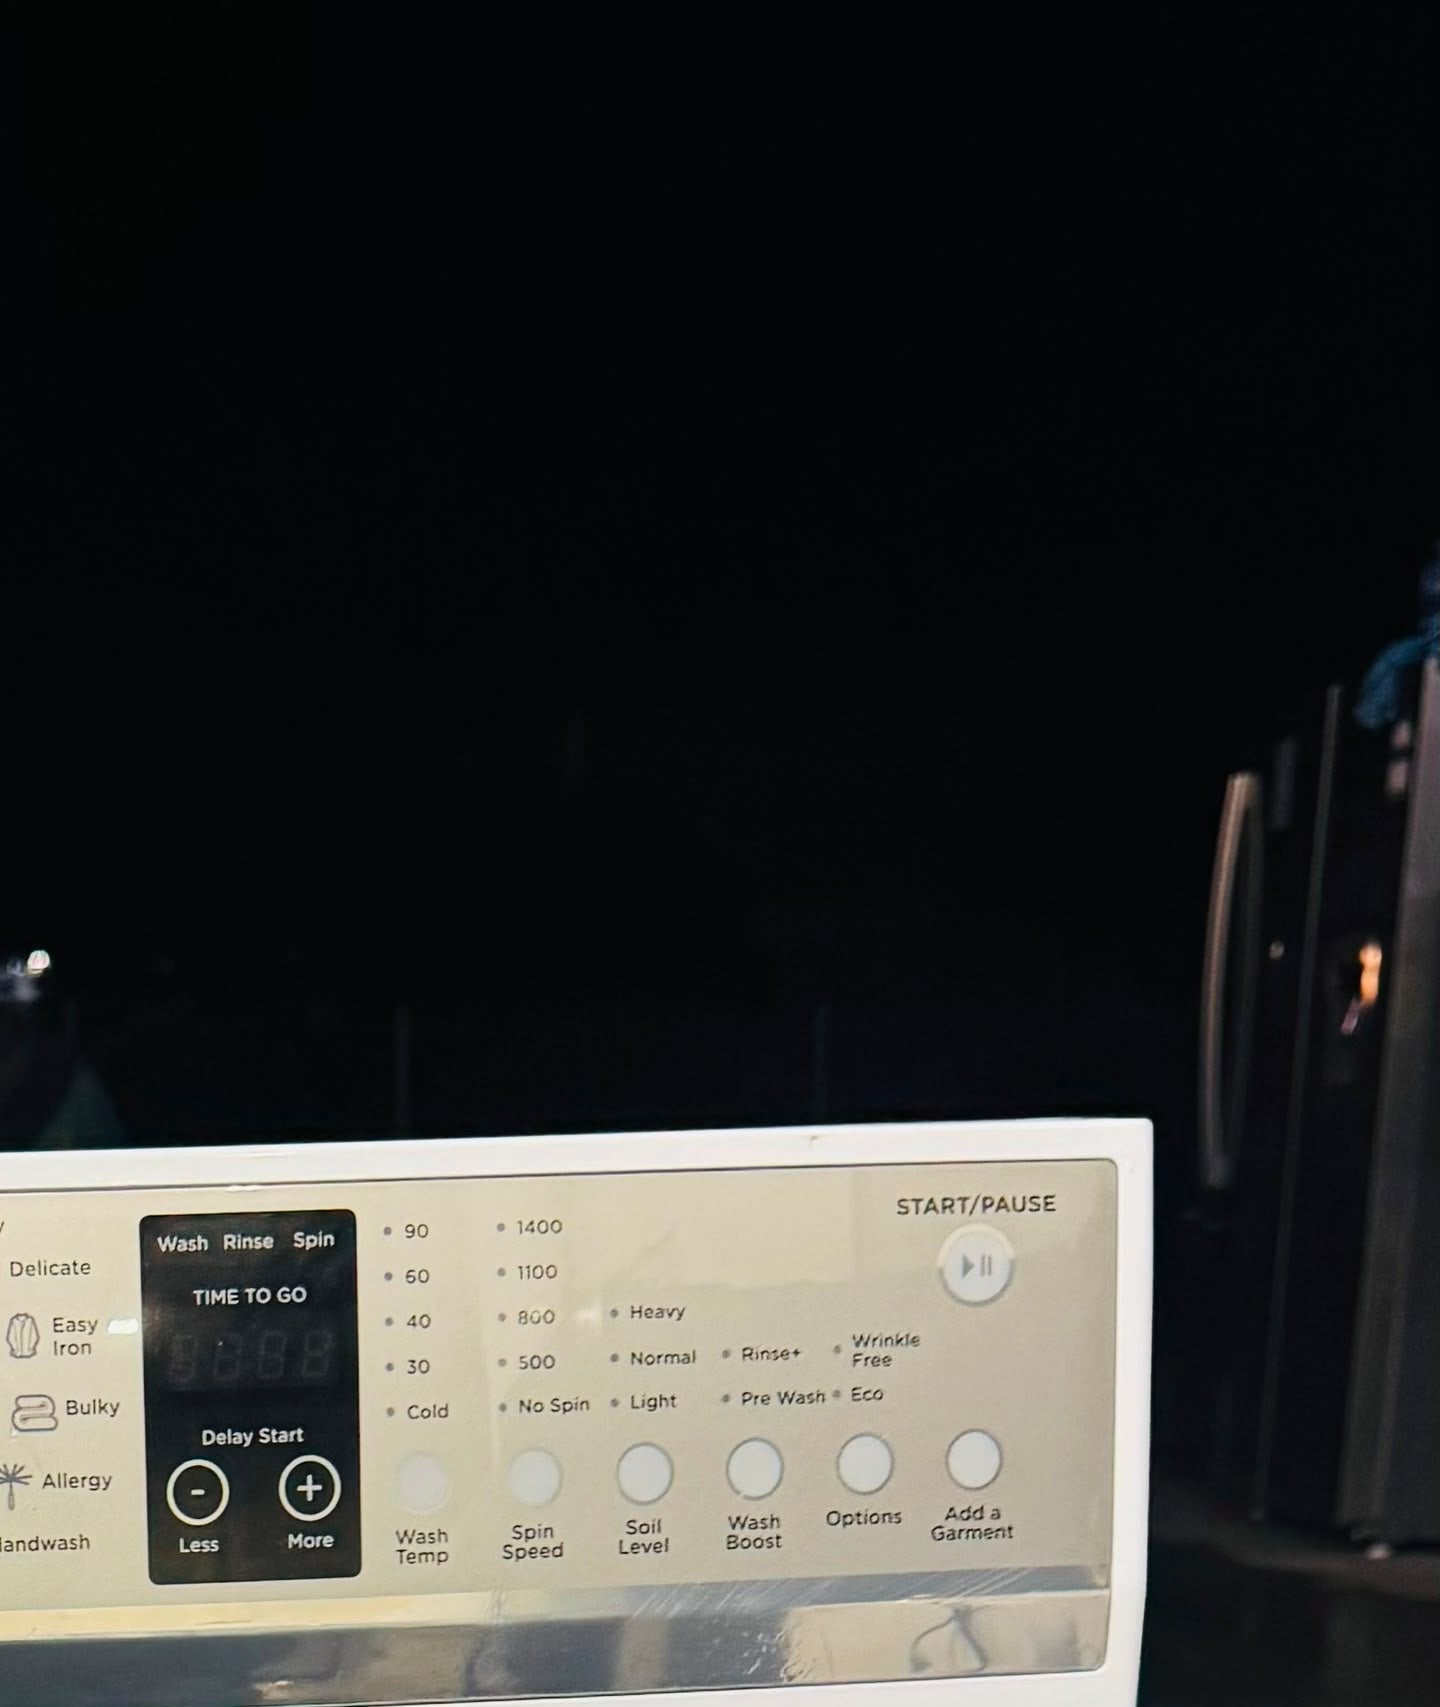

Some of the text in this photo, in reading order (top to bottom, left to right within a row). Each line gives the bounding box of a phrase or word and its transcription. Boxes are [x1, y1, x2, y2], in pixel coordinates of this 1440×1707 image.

[897, 1195, 1056, 1215] START/PAUSE
[405, 1224, 428, 1238] 90
[518, 1220, 562, 1234] 1400
[157, 1235, 208, 1252] Wash
[224, 1234, 273, 1250] Rinse
[294, 1231, 334, 1250] Spin
[10, 1260, 90, 1277] Delicate
[518, 1265, 557, 1279] 1100
[406, 1269, 429, 1284] 60
[193, 1287, 306, 1305] TIME TO GO
[519, 1309, 555, 1325] 800
[631, 1306, 685, 1321] Heavy
[53, 1317, 97, 1335] Easy
[407, 1314, 431, 1329] 40
[54, 1341, 91, 1355] Iron
[853, 1334, 920, 1347] Wrinkle
[631, 1350, 696, 1365] Normal
[742, 1347, 800, 1360] Rinse+
[853, 1353, 892, 1367] Free
[408, 1360, 430, 1374] 30
[520, 1355, 555, 1369] 500
[742, 1390, 825, 1405] Pre Wash
[852, 1387, 883, 1401] Eco
[67, 1399, 119, 1417] Bulky
[520, 1397, 589, 1414] No Spin
[631, 1394, 676, 1412] Light
[408, 1404, 448, 1419] Cold
[202, 1428, 304, 1447] Delay Start
[43, 1473, 111, 1491] Allergy
[827, 1511, 901, 1528] Options
[945, 1506, 1001, 1521] Add a
[626, 1520, 661, 1535] Soil
[728, 1514, 779, 1530] Wash
[396, 1529, 448, 1544] Wash
[512, 1524, 553, 1542] Spin
[931, 1525, 1013, 1541] Garment
[180, 1538, 219, 1552] Less
[288, 1534, 334, 1548] More
[619, 1538, 668, 1554] Level
[727, 1535, 781, 1550] Boost
[396, 1549, 448, 1565] Temp
[503, 1540, 563, 1561] Speed
